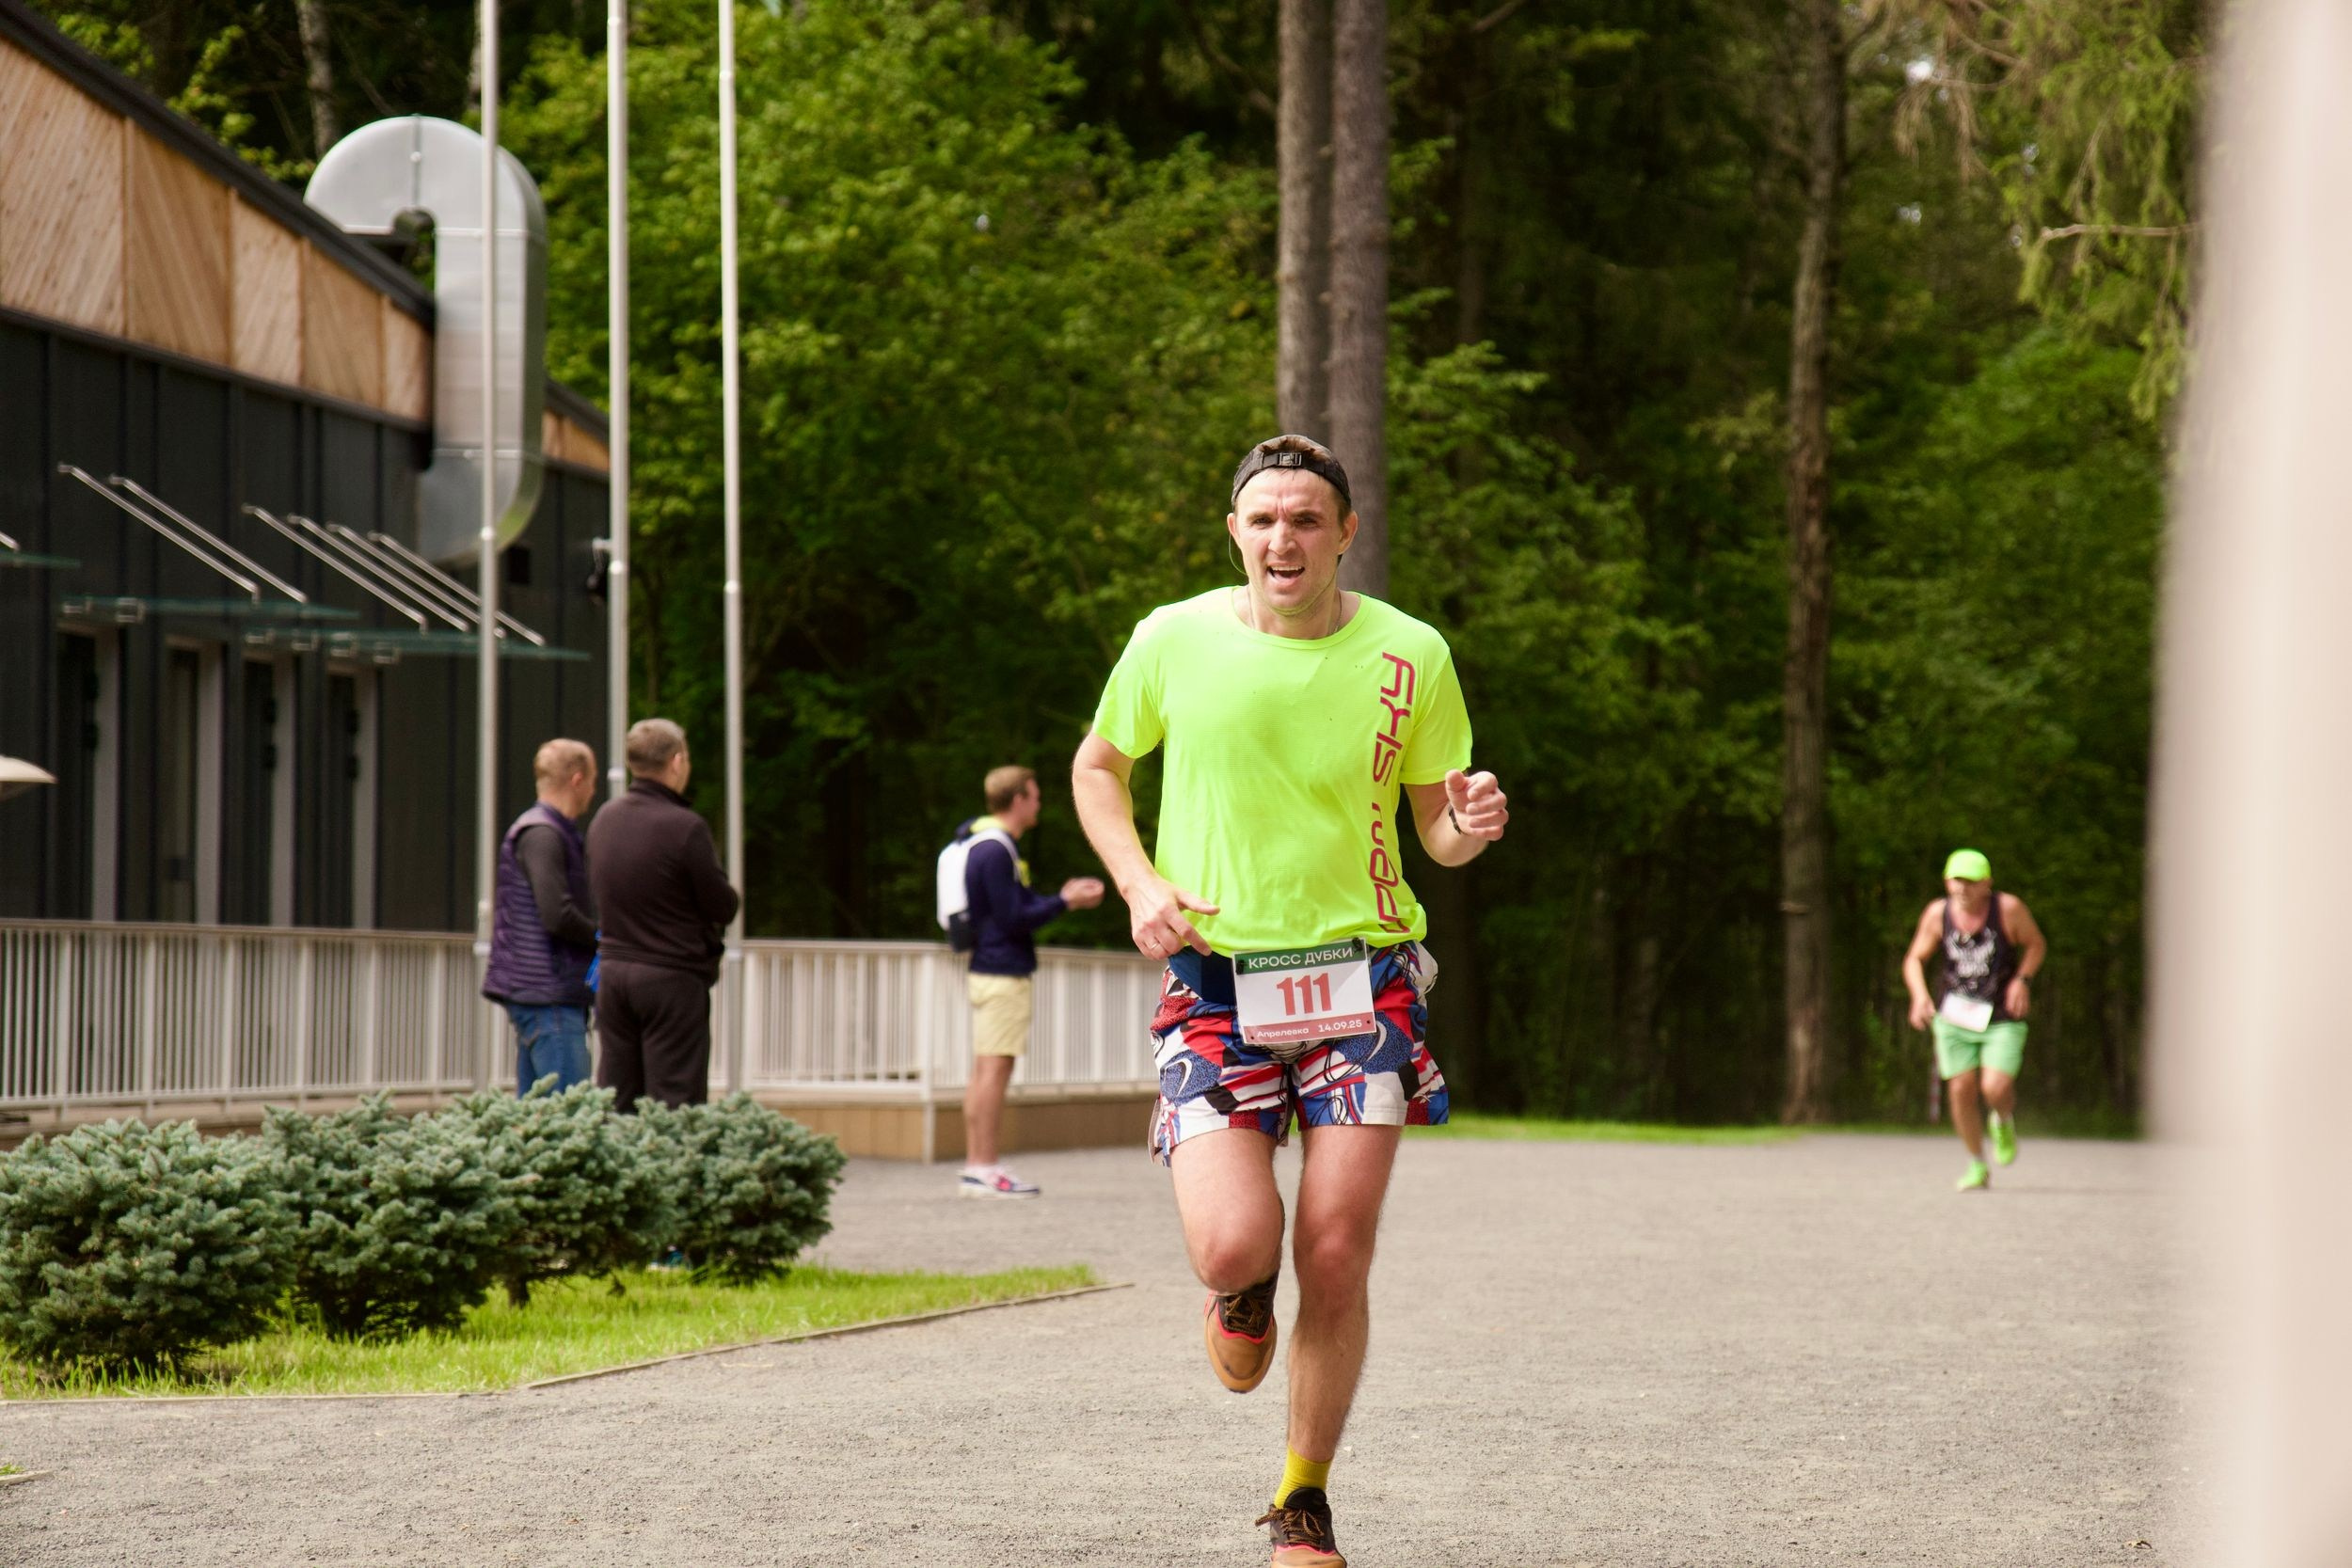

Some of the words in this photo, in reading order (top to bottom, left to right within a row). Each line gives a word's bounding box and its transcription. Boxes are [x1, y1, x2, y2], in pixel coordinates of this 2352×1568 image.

[1248, 954, 1302, 969] КРОСС
[1305, 946, 1354, 966] ДУБКИ
[1276, 973, 1332, 1016] 111
[1318, 1019, 1362, 1033] 14.09.25
